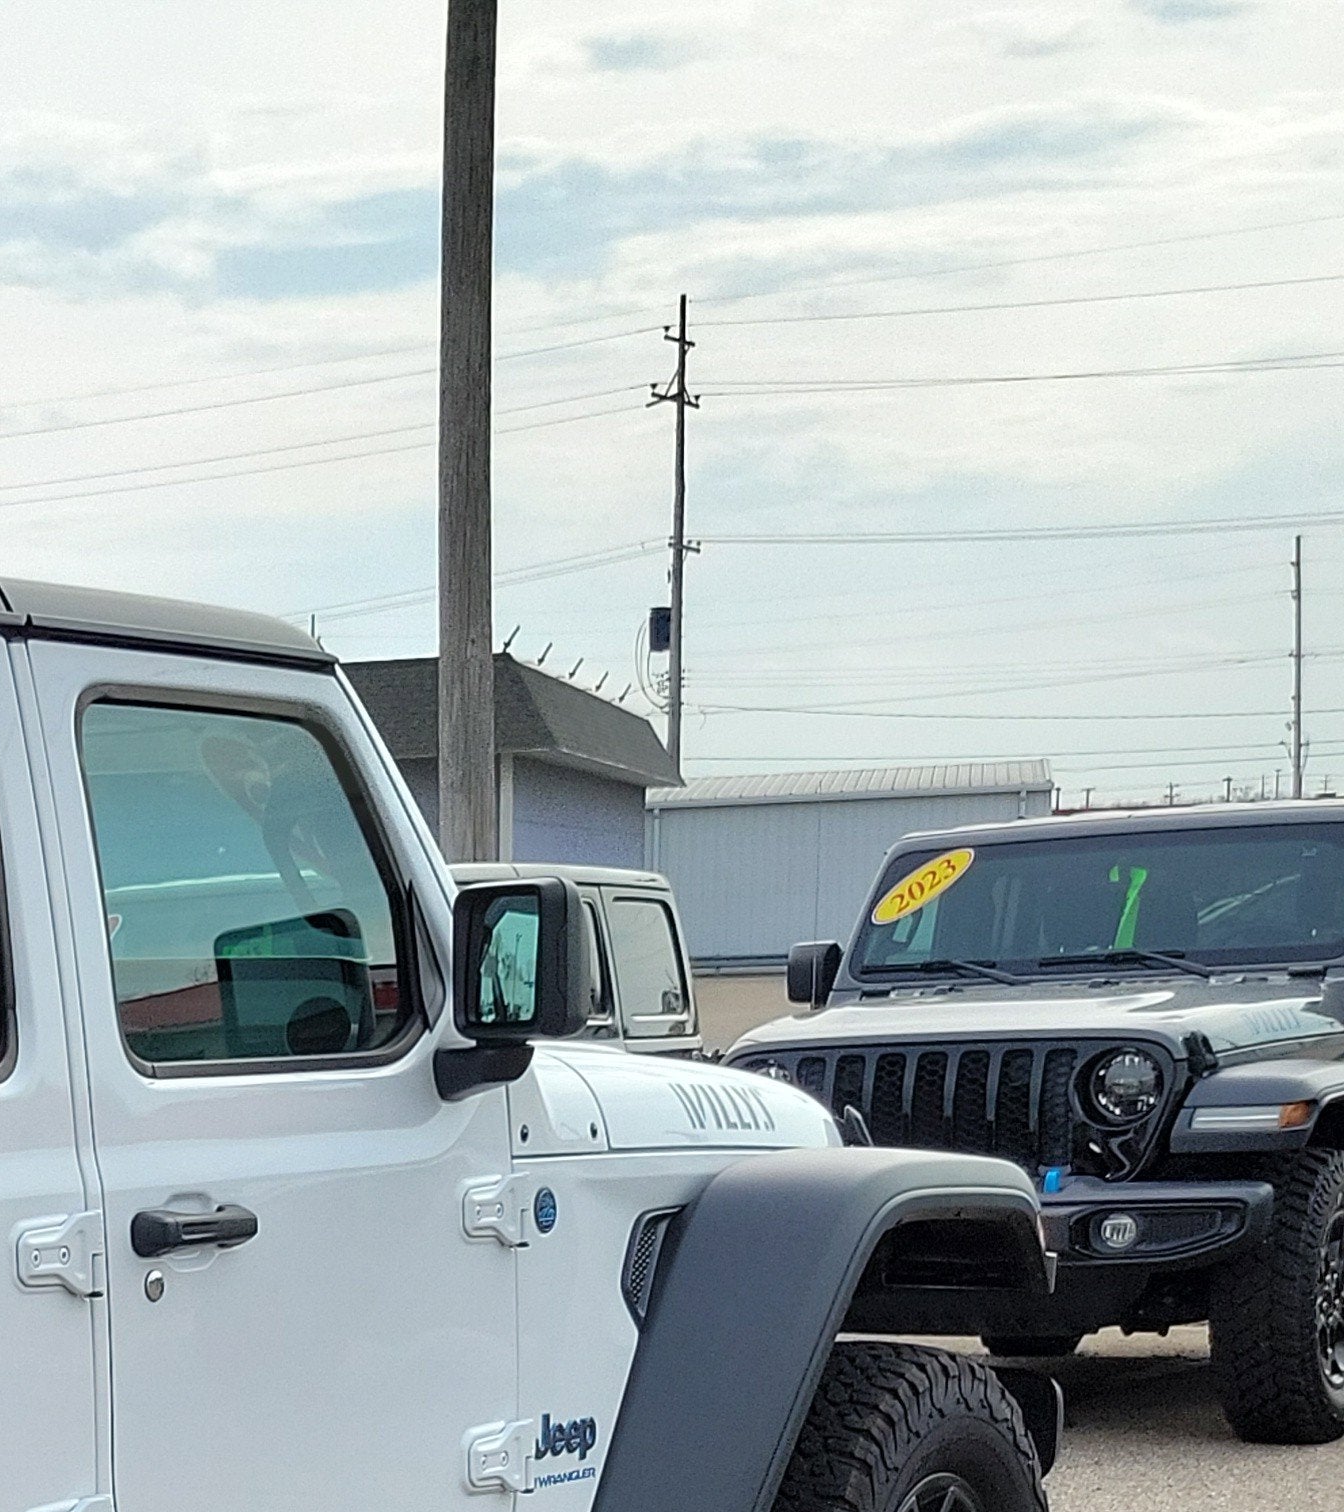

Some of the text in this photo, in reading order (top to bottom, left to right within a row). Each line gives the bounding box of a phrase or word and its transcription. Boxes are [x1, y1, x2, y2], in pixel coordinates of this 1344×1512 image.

[890, 858, 957, 914] 2023
[669, 1082, 776, 1131] WILLYS
[535, 1413, 596, 1460] Jeep
[535, 1467, 596, 1488] WRANGLER
